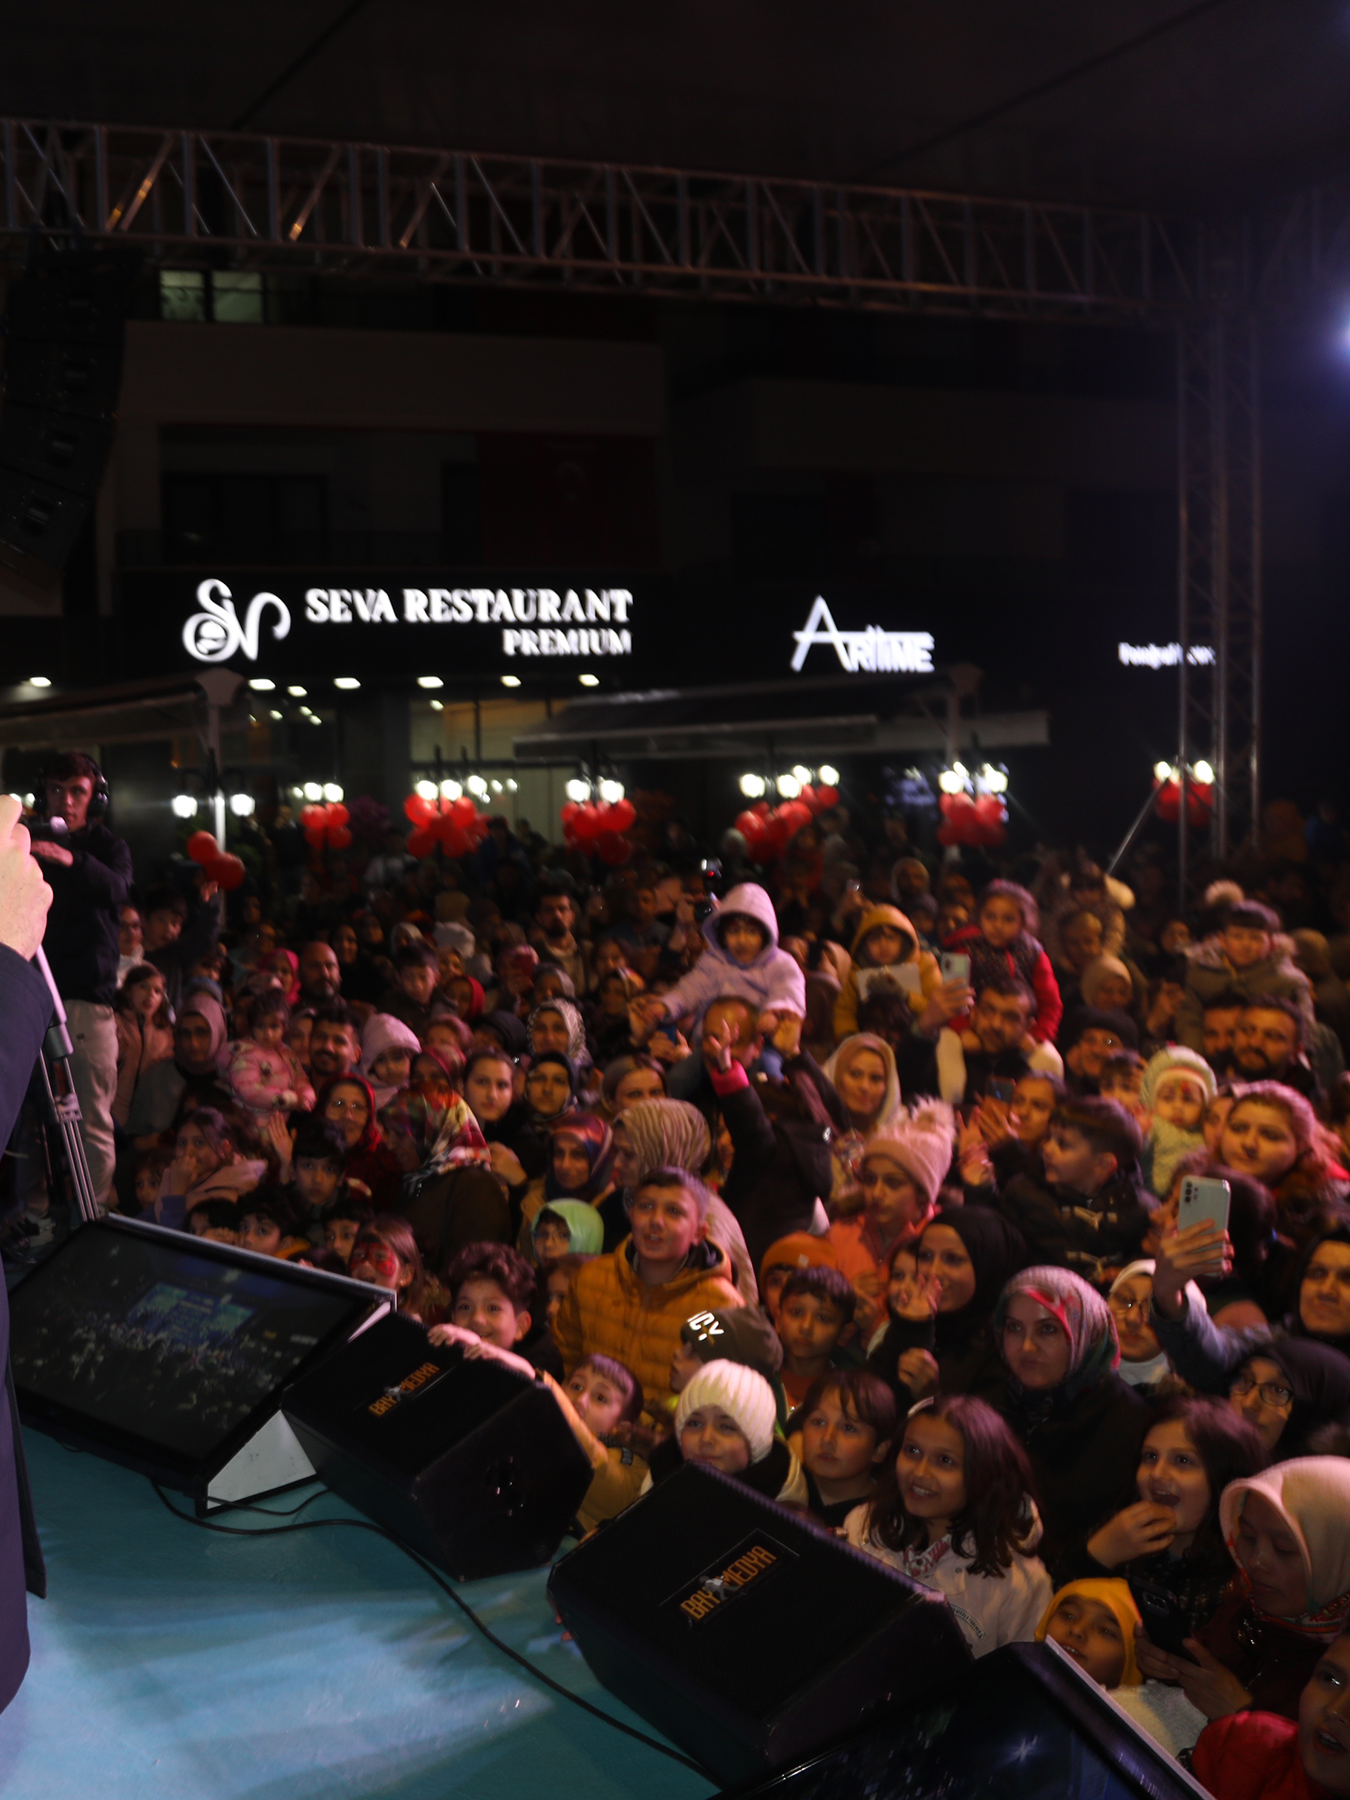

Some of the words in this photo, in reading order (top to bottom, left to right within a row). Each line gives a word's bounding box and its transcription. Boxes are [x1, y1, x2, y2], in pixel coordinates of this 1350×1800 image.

[305, 588, 399, 623] SEVA
[402, 588, 634, 623] RESTAURANT
[503, 628, 633, 656] PREMIUM
[368, 1392, 398, 1417] BAY
[399, 1361, 441, 1392] MEDYA
[679, 1585, 721, 1620] BAY
[715, 1545, 778, 1586] MEDYA
